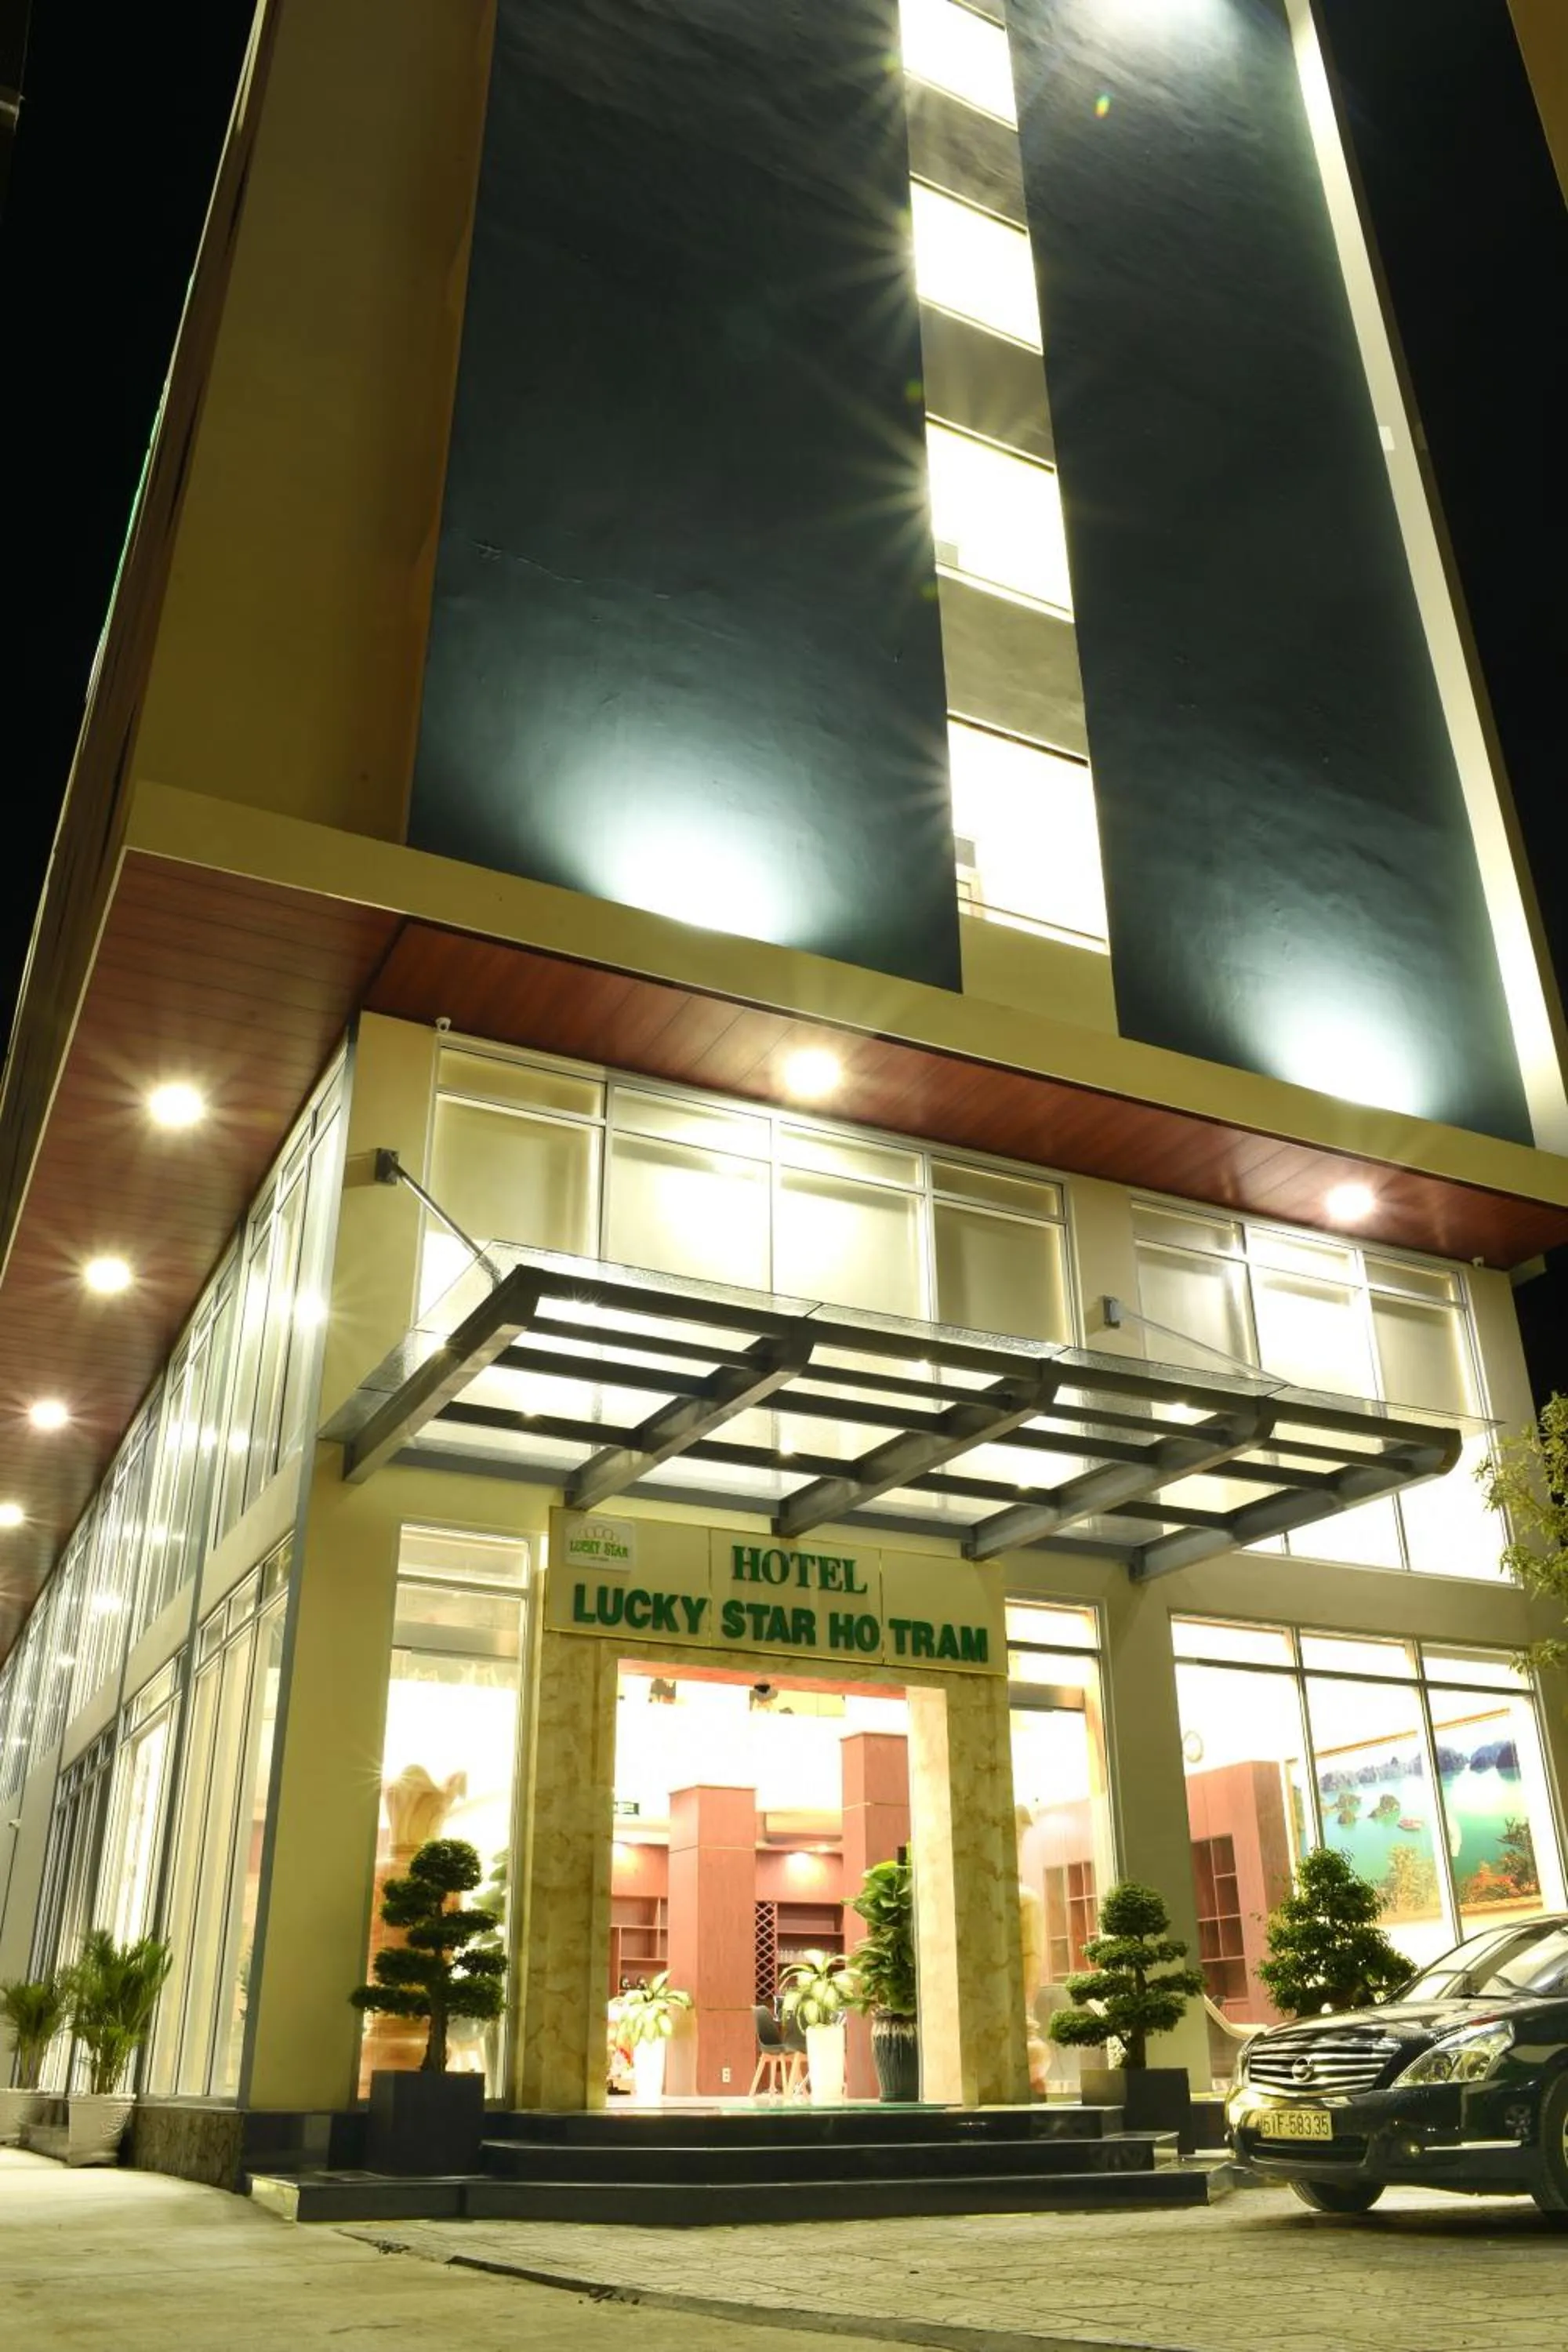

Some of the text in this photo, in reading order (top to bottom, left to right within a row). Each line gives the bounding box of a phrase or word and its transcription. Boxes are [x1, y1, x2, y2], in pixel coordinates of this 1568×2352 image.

[604, 1542, 629, 1558] STAR
[731, 1545, 868, 1595] HOTEL
[573, 1583, 989, 1663] LUCKY STAR HO TRAM
